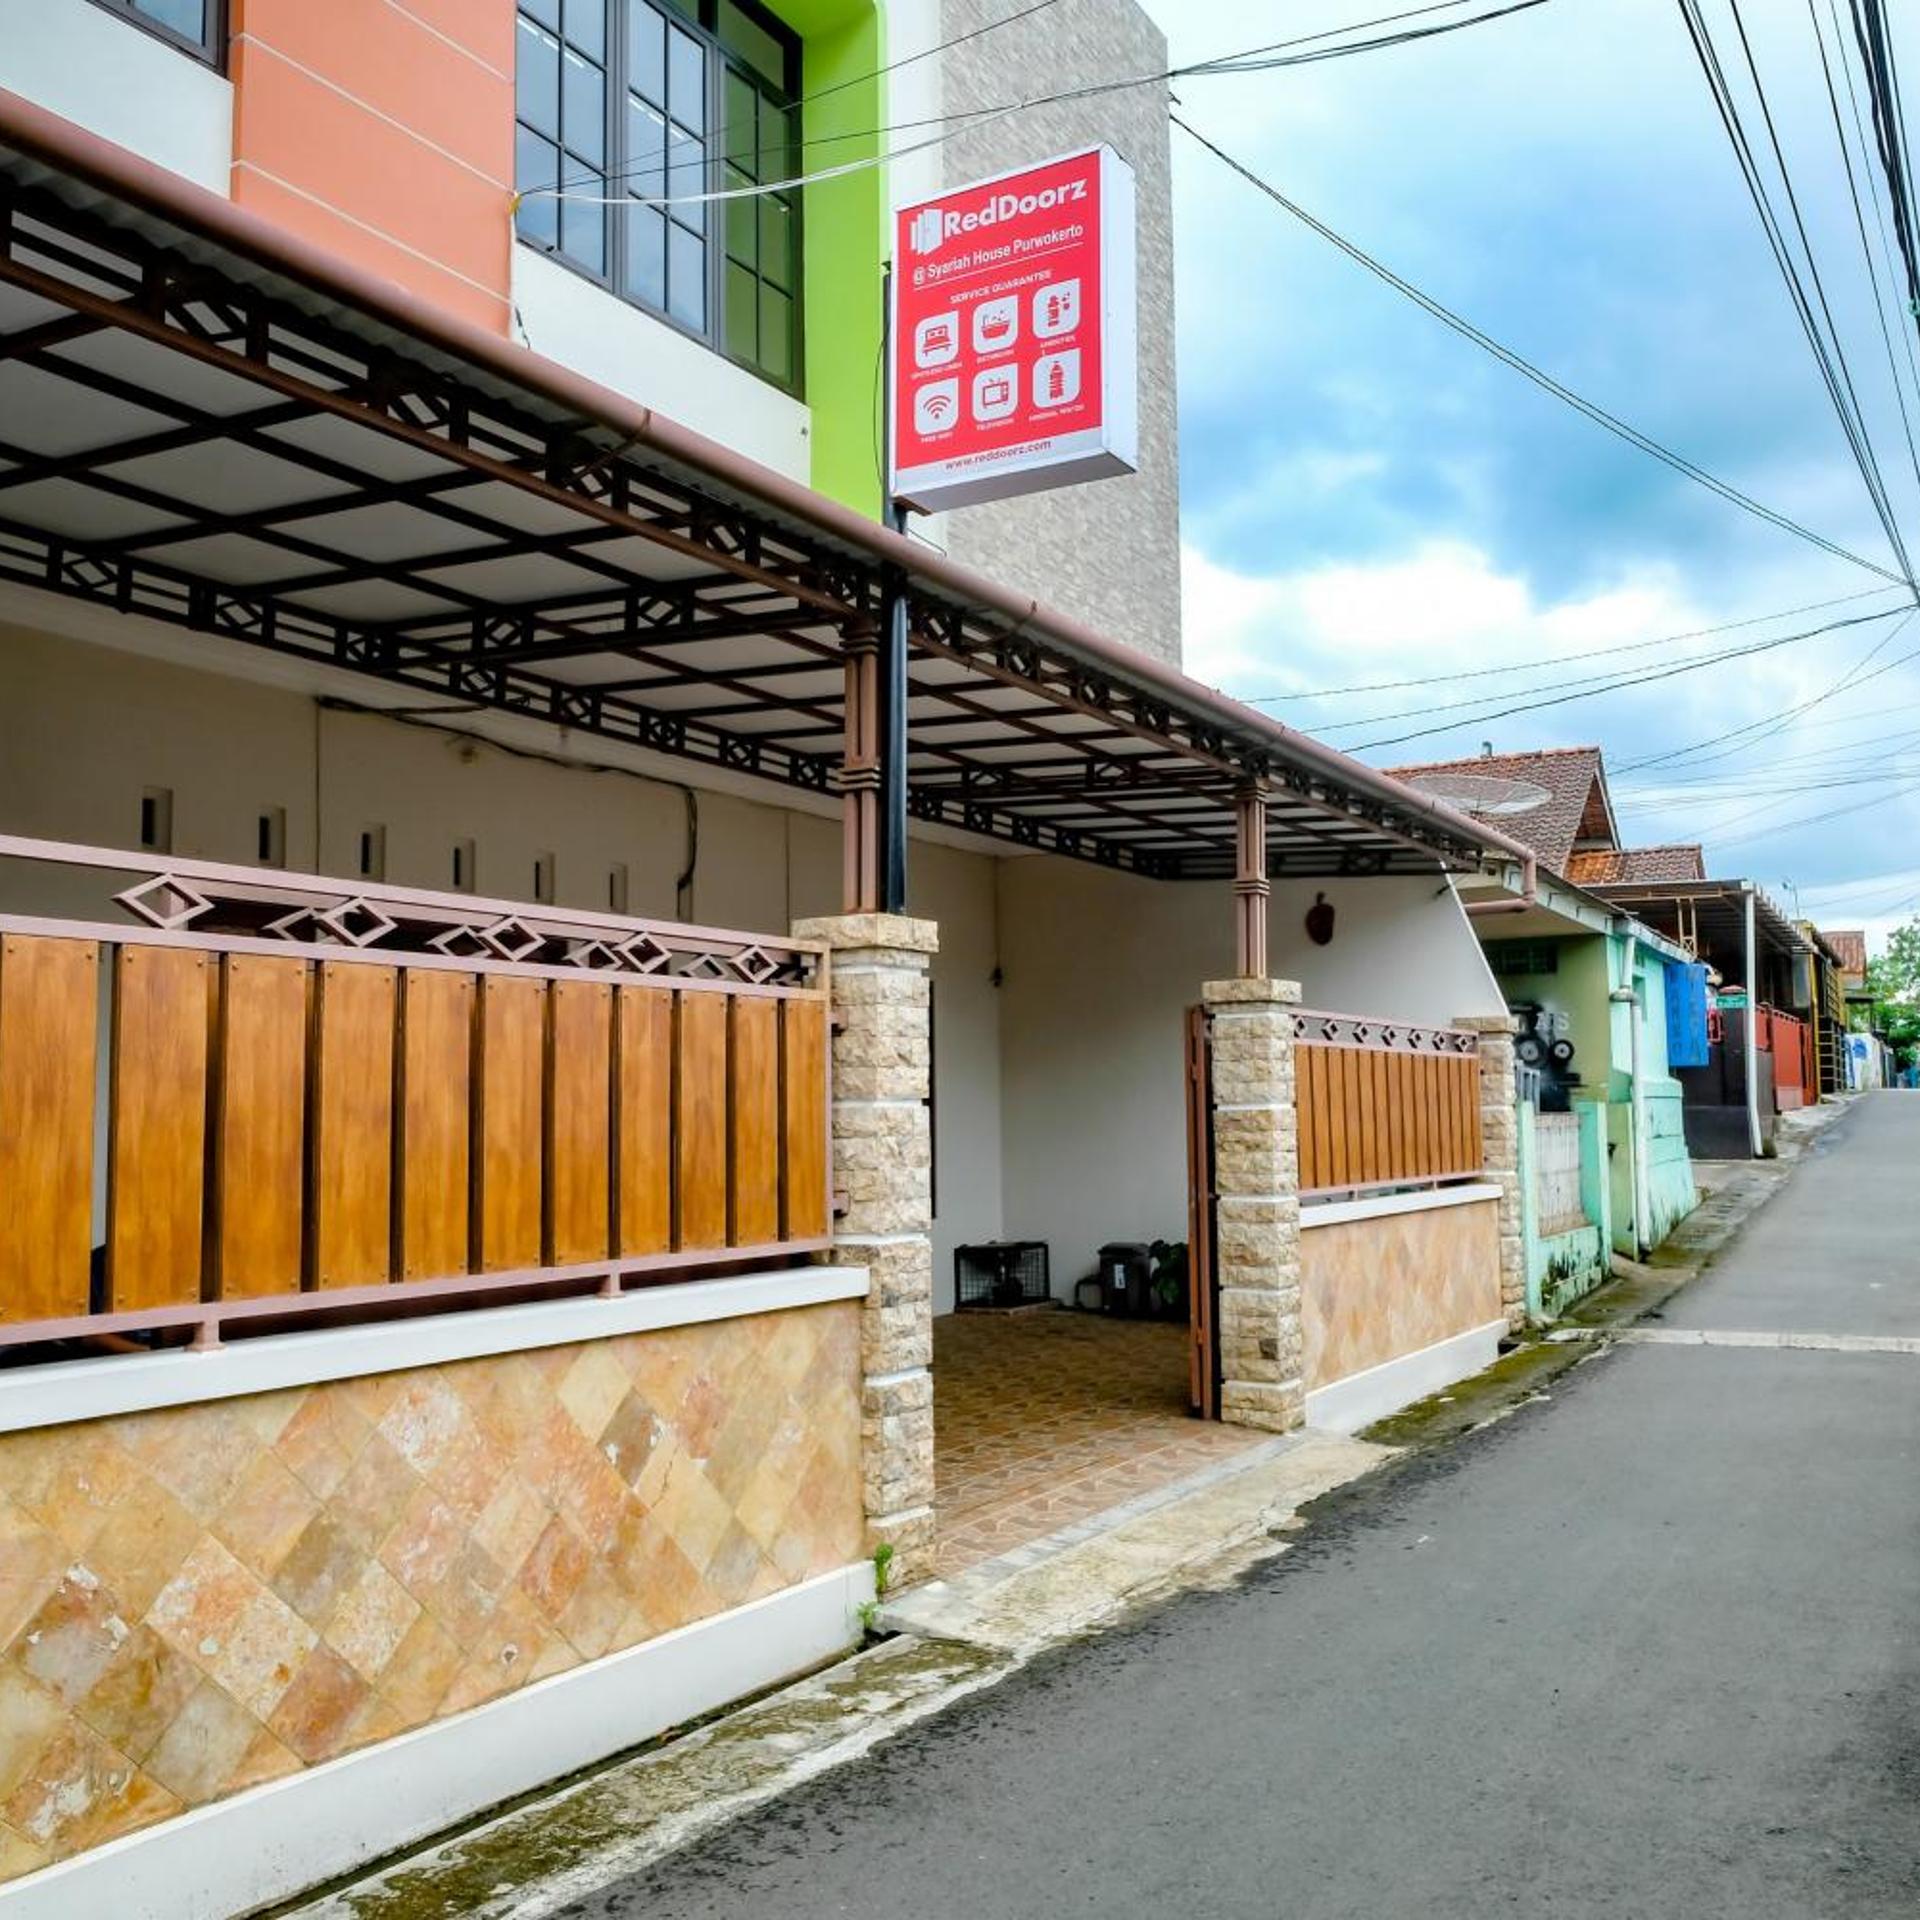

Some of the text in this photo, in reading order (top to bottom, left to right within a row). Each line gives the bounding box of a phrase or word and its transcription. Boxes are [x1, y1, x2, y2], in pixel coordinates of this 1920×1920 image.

[944, 178, 1087, 238] RedDoorz
[913, 224, 1084, 284] @ Syariah House Purwokerto
[950, 285, 990, 304] SERVICE
[945, 440, 1051, 470] www.reddoorz.com
